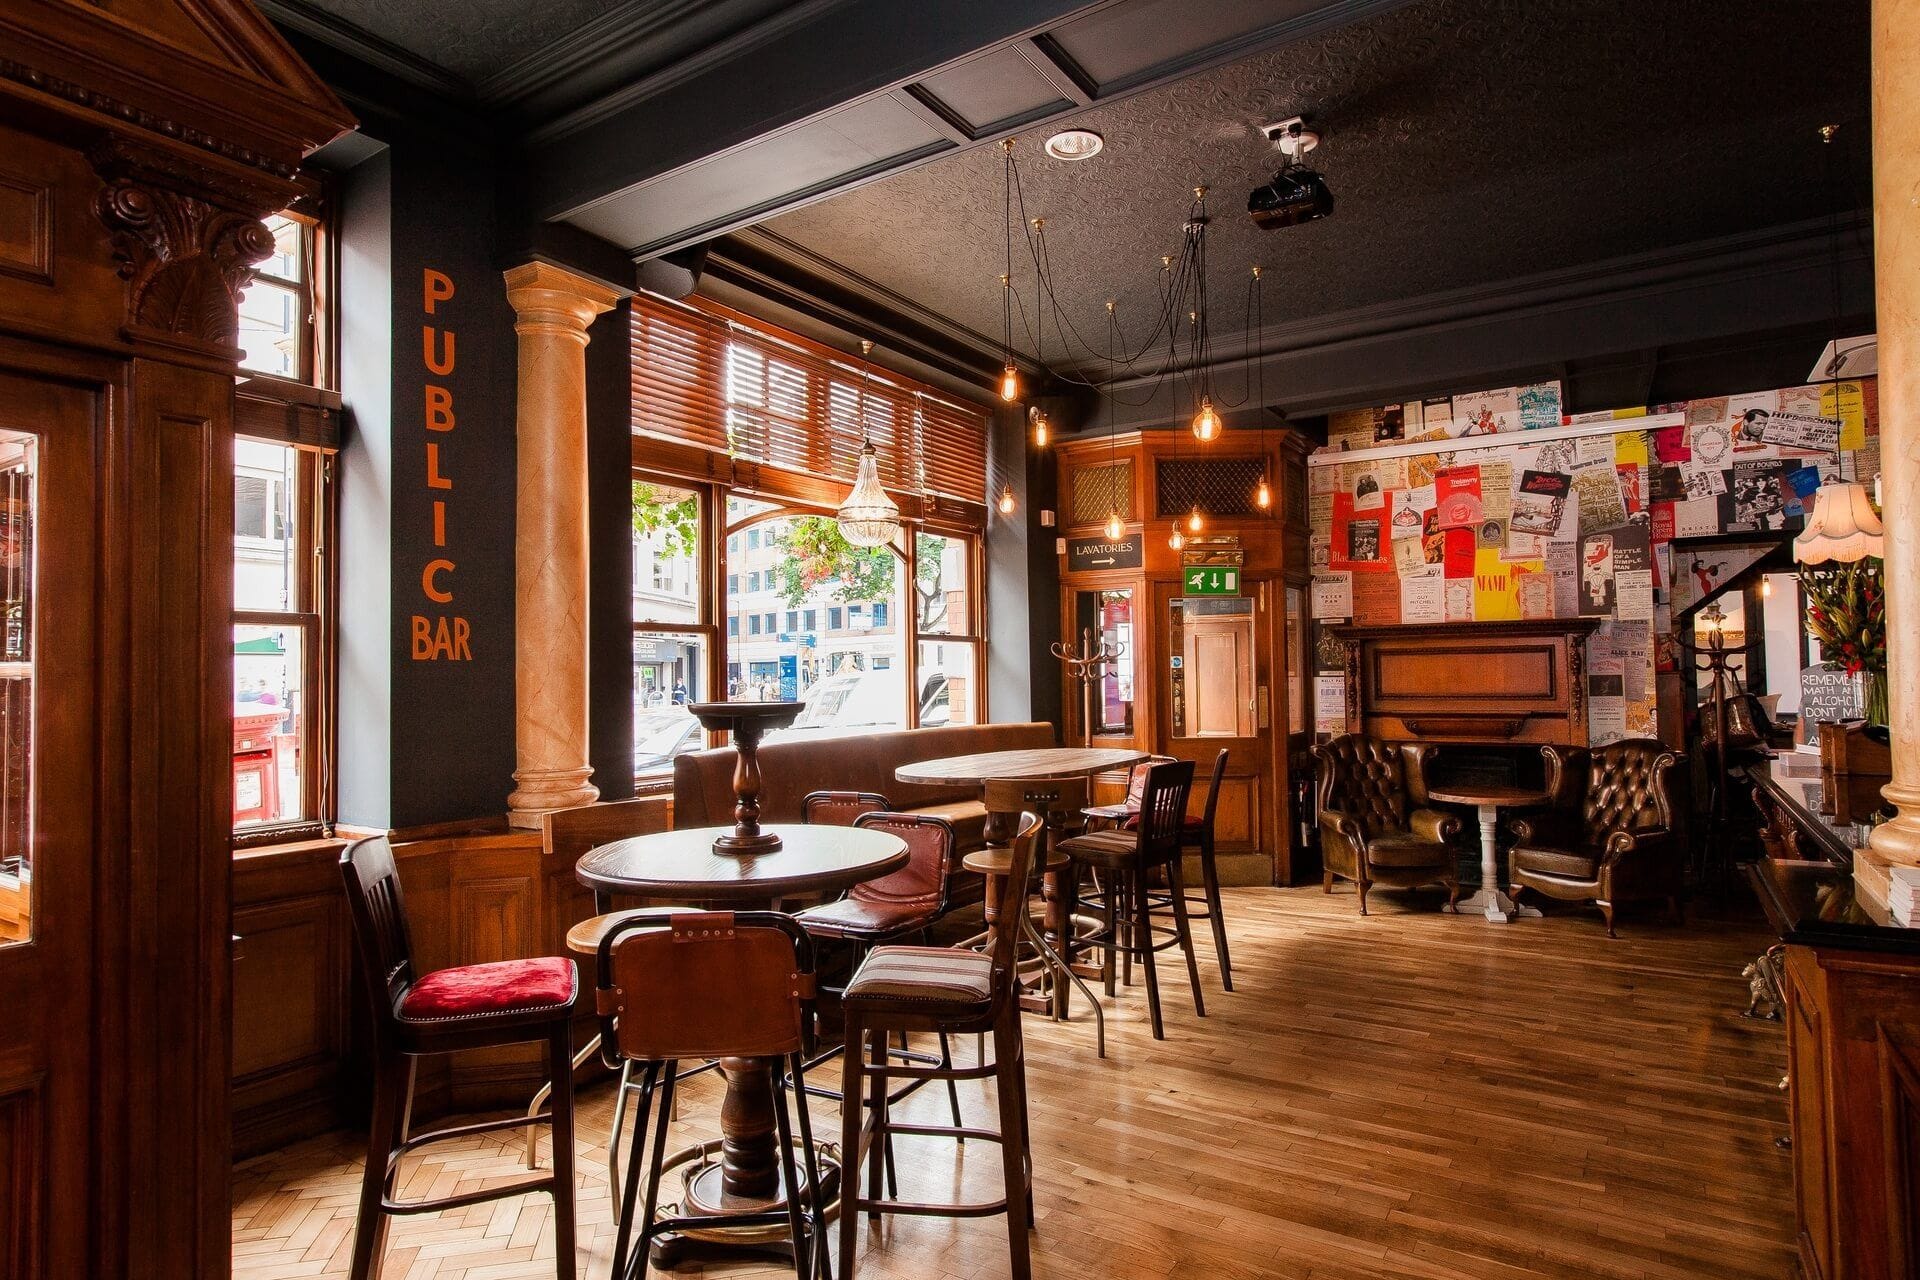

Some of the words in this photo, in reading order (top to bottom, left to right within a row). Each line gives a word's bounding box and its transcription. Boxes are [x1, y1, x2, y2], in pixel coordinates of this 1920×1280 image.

[423, 268, 455, 604] PUBLIC
[1076, 542, 1133, 556] LAVATORIES
[411, 616, 472, 661] BAR
[1803, 686, 1835, 695] MATH
[1805, 707, 1836, 718] DONT
